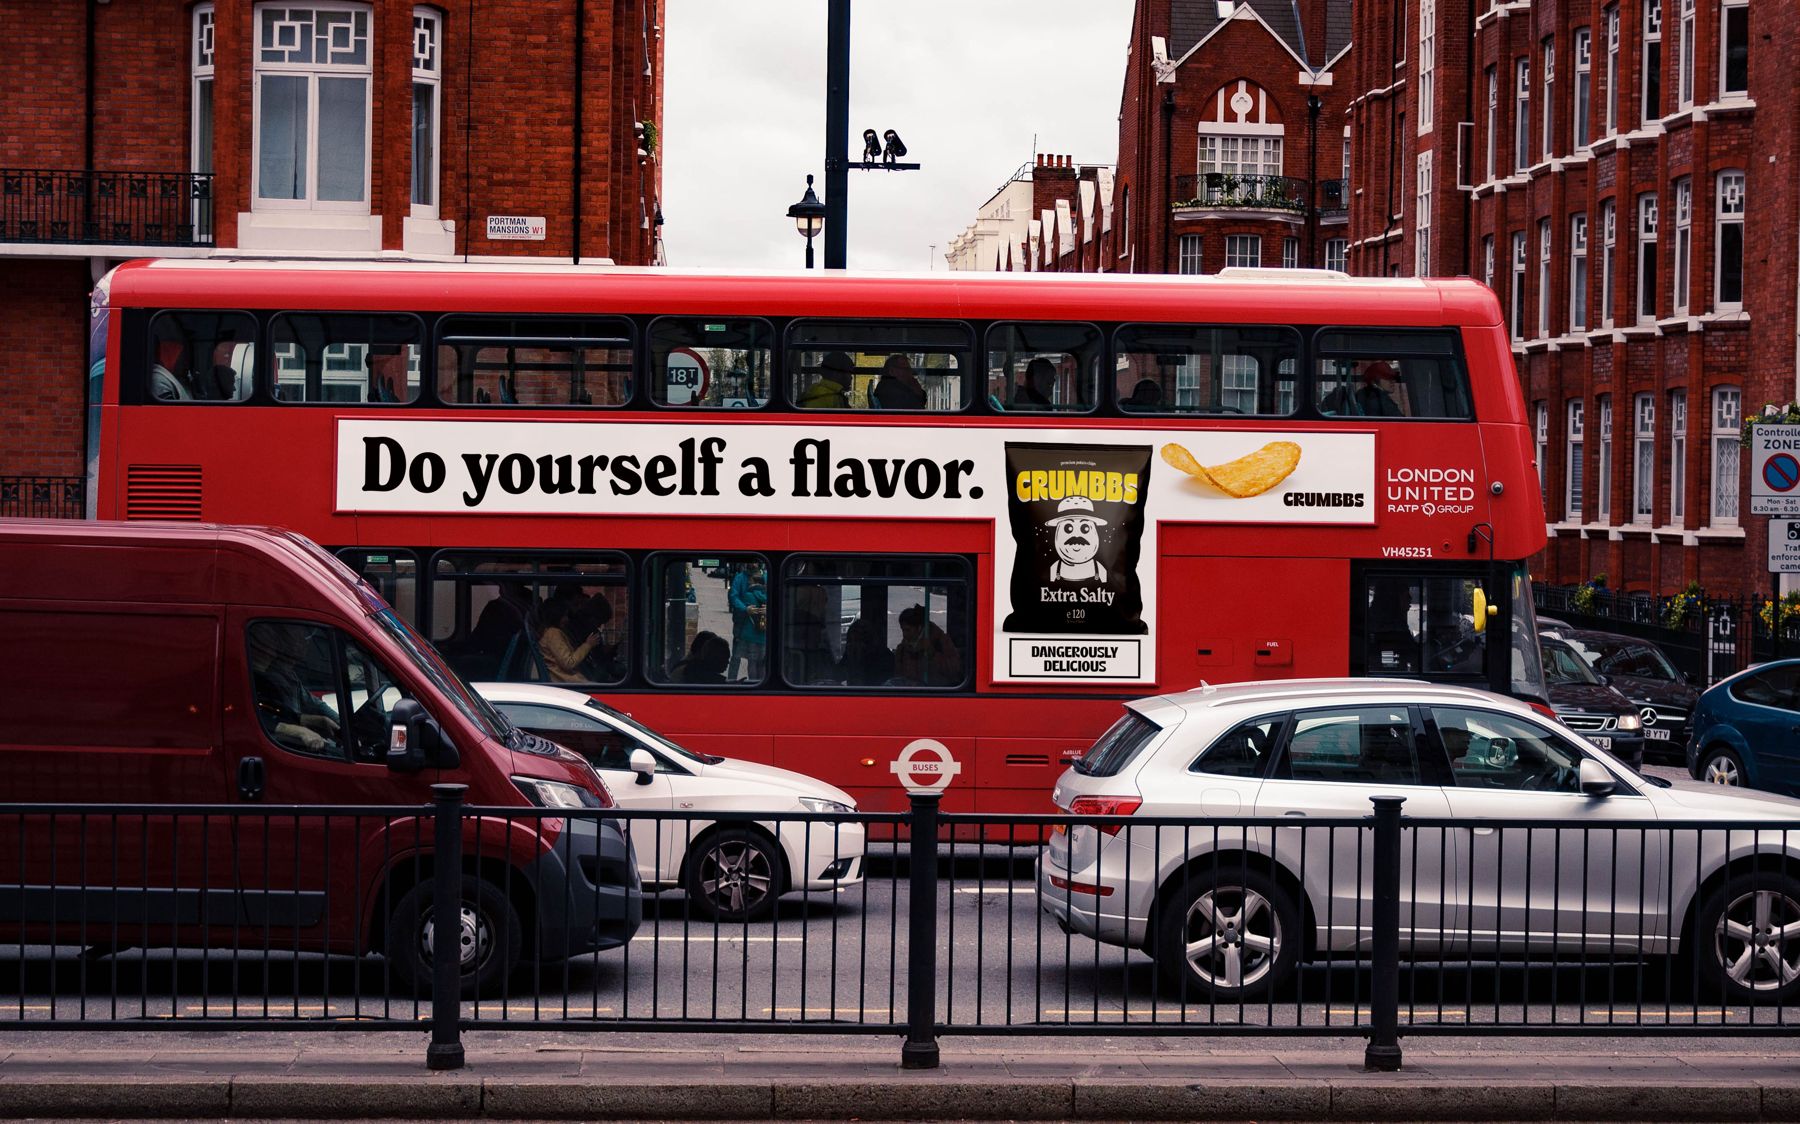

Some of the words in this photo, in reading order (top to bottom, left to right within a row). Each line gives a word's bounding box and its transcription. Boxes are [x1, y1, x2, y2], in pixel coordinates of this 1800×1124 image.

[489, 217, 527, 226] PORTMAN
[489, 226, 530, 234] MANSIONS
[532, 226, 543, 234] W1
[1763, 439, 1800, 450] ZONE
[362, 436, 446, 494] Do
[461, 437, 726, 507] yourself
[738, 456, 776, 497] a
[789, 438, 984, 500] flavor.
[1387, 468, 1475, 483] LONDON
[1016, 470, 1139, 505] CRUMBBS
[1387, 486, 1475, 501] UNITED
[1283, 492, 1365, 508] CRUMBBS
[1387, 504, 1419, 513] RATP
[1437, 504, 1474, 514] GROUP
[1382, 547, 1433, 557] VH45251
[1040, 587, 1078, 602] Extra
[1080, 587, 1115, 607] Salty
[1072, 609, 1086, 619] 120
[1031, 646, 1119, 658] DANGEROUSLY
[1043, 660, 1107, 672] DELICIOUS
